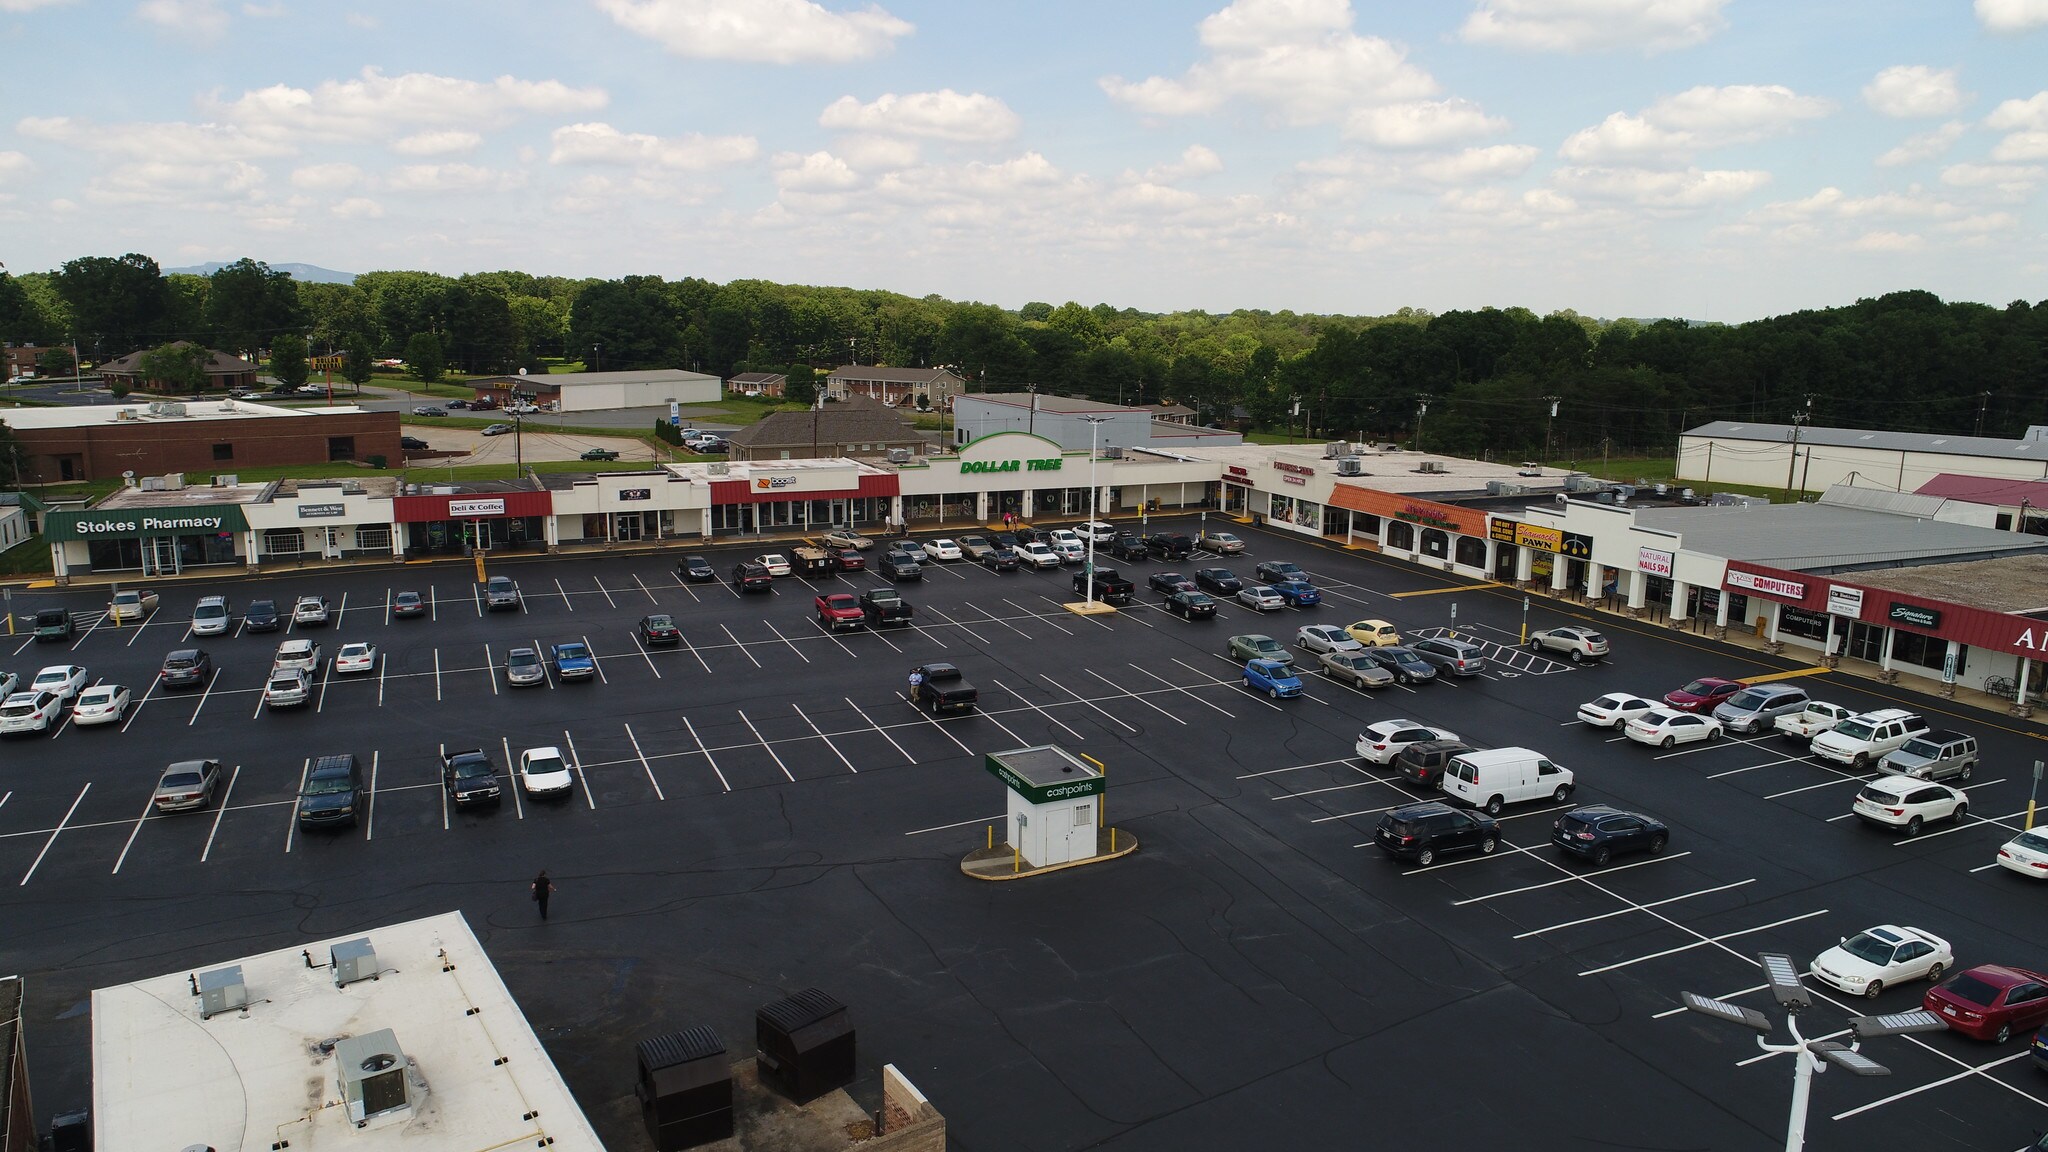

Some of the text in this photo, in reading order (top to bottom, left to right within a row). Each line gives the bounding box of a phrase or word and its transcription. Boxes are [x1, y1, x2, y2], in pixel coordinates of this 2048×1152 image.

[960, 458, 1063, 474] DOLLAR TREE
[771, 476, 796, 484] boost
[478, 503, 503, 511] Coffee
[76, 516, 222, 534] Stokes Pharmacy
[1522, 537, 1552, 550] PAWN
[1640, 551, 1669, 563] NATURAL
[1640, 560, 1669, 574] NAILS SPA
[1785, 613, 1822, 627] COMPUTERS
[1891, 607, 1933, 620] Signature
[998, 768, 1020, 790] cashpoints
[1046, 782, 1093, 797] cashpoints
